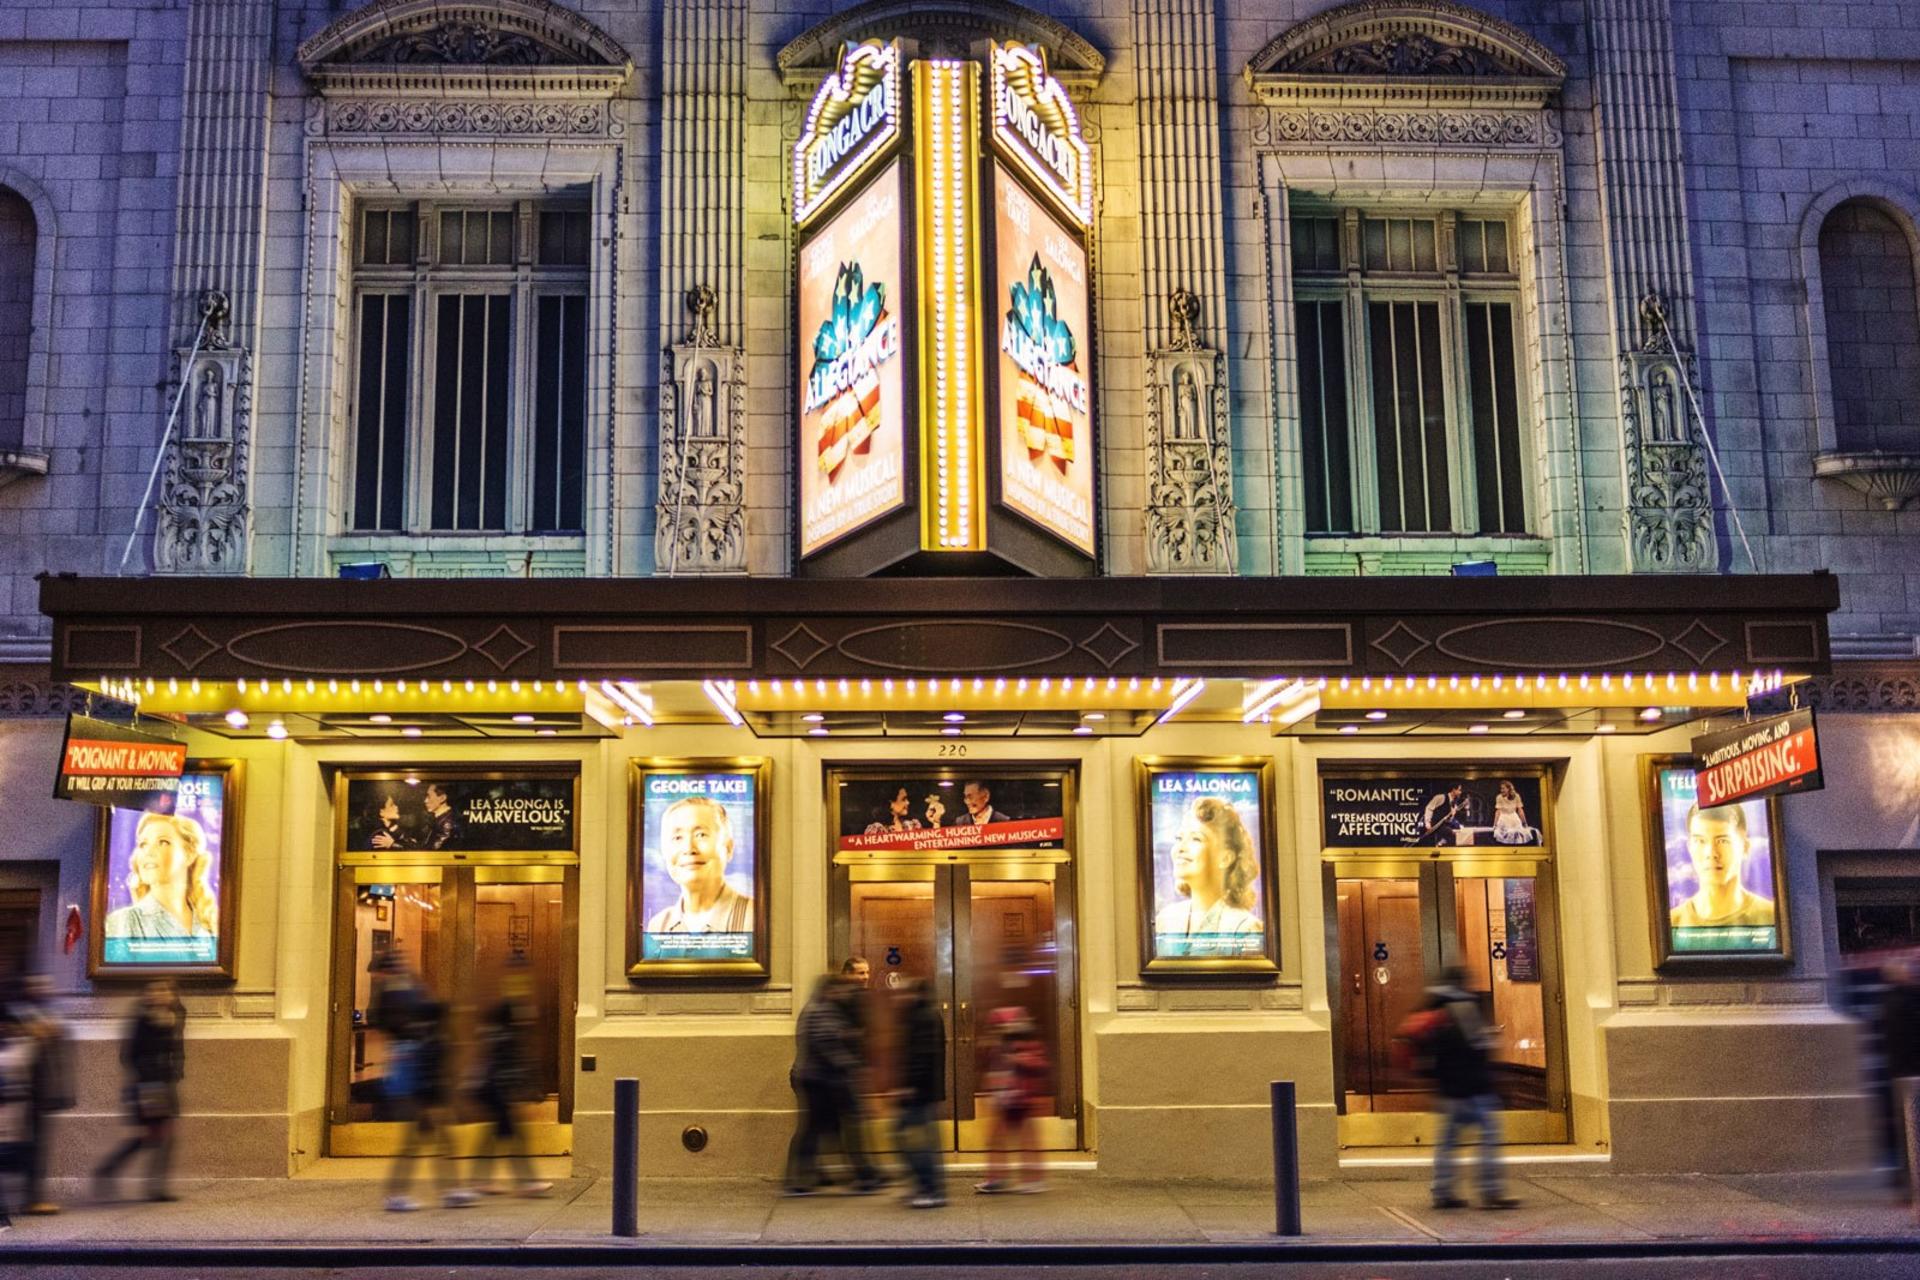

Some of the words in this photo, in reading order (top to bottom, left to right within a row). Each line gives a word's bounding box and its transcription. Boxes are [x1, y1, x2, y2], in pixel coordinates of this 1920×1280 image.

[1774, 720, 1790, 740] AND
[938, 744, 967, 757] 220
[128, 748, 137, 770] &
[1707, 736, 1804, 802] SURPRISING."
[650, 780, 706, 794] GEORGE
[708, 780, 747, 794] TAKEI
[1158, 779, 1183, 793] LEA
[1185, 779, 1252, 793] SALONGA
[1330, 788, 1423, 801] "ROMANTIC."
[470, 799, 491, 810] LEA
[494, 799, 551, 810] SALONGA
[554, 799, 564, 810] IS
[463, 810, 570, 823] "MARVELOUS."
[1331, 812, 1420, 823] "TREMENDOUSLY
[945, 825, 982, 838] HUGELY
[1338, 822, 1424, 836] AFFECTING."
[914, 835, 982, 850] ENTERTAINING
[983, 833, 1006, 843] NEW
